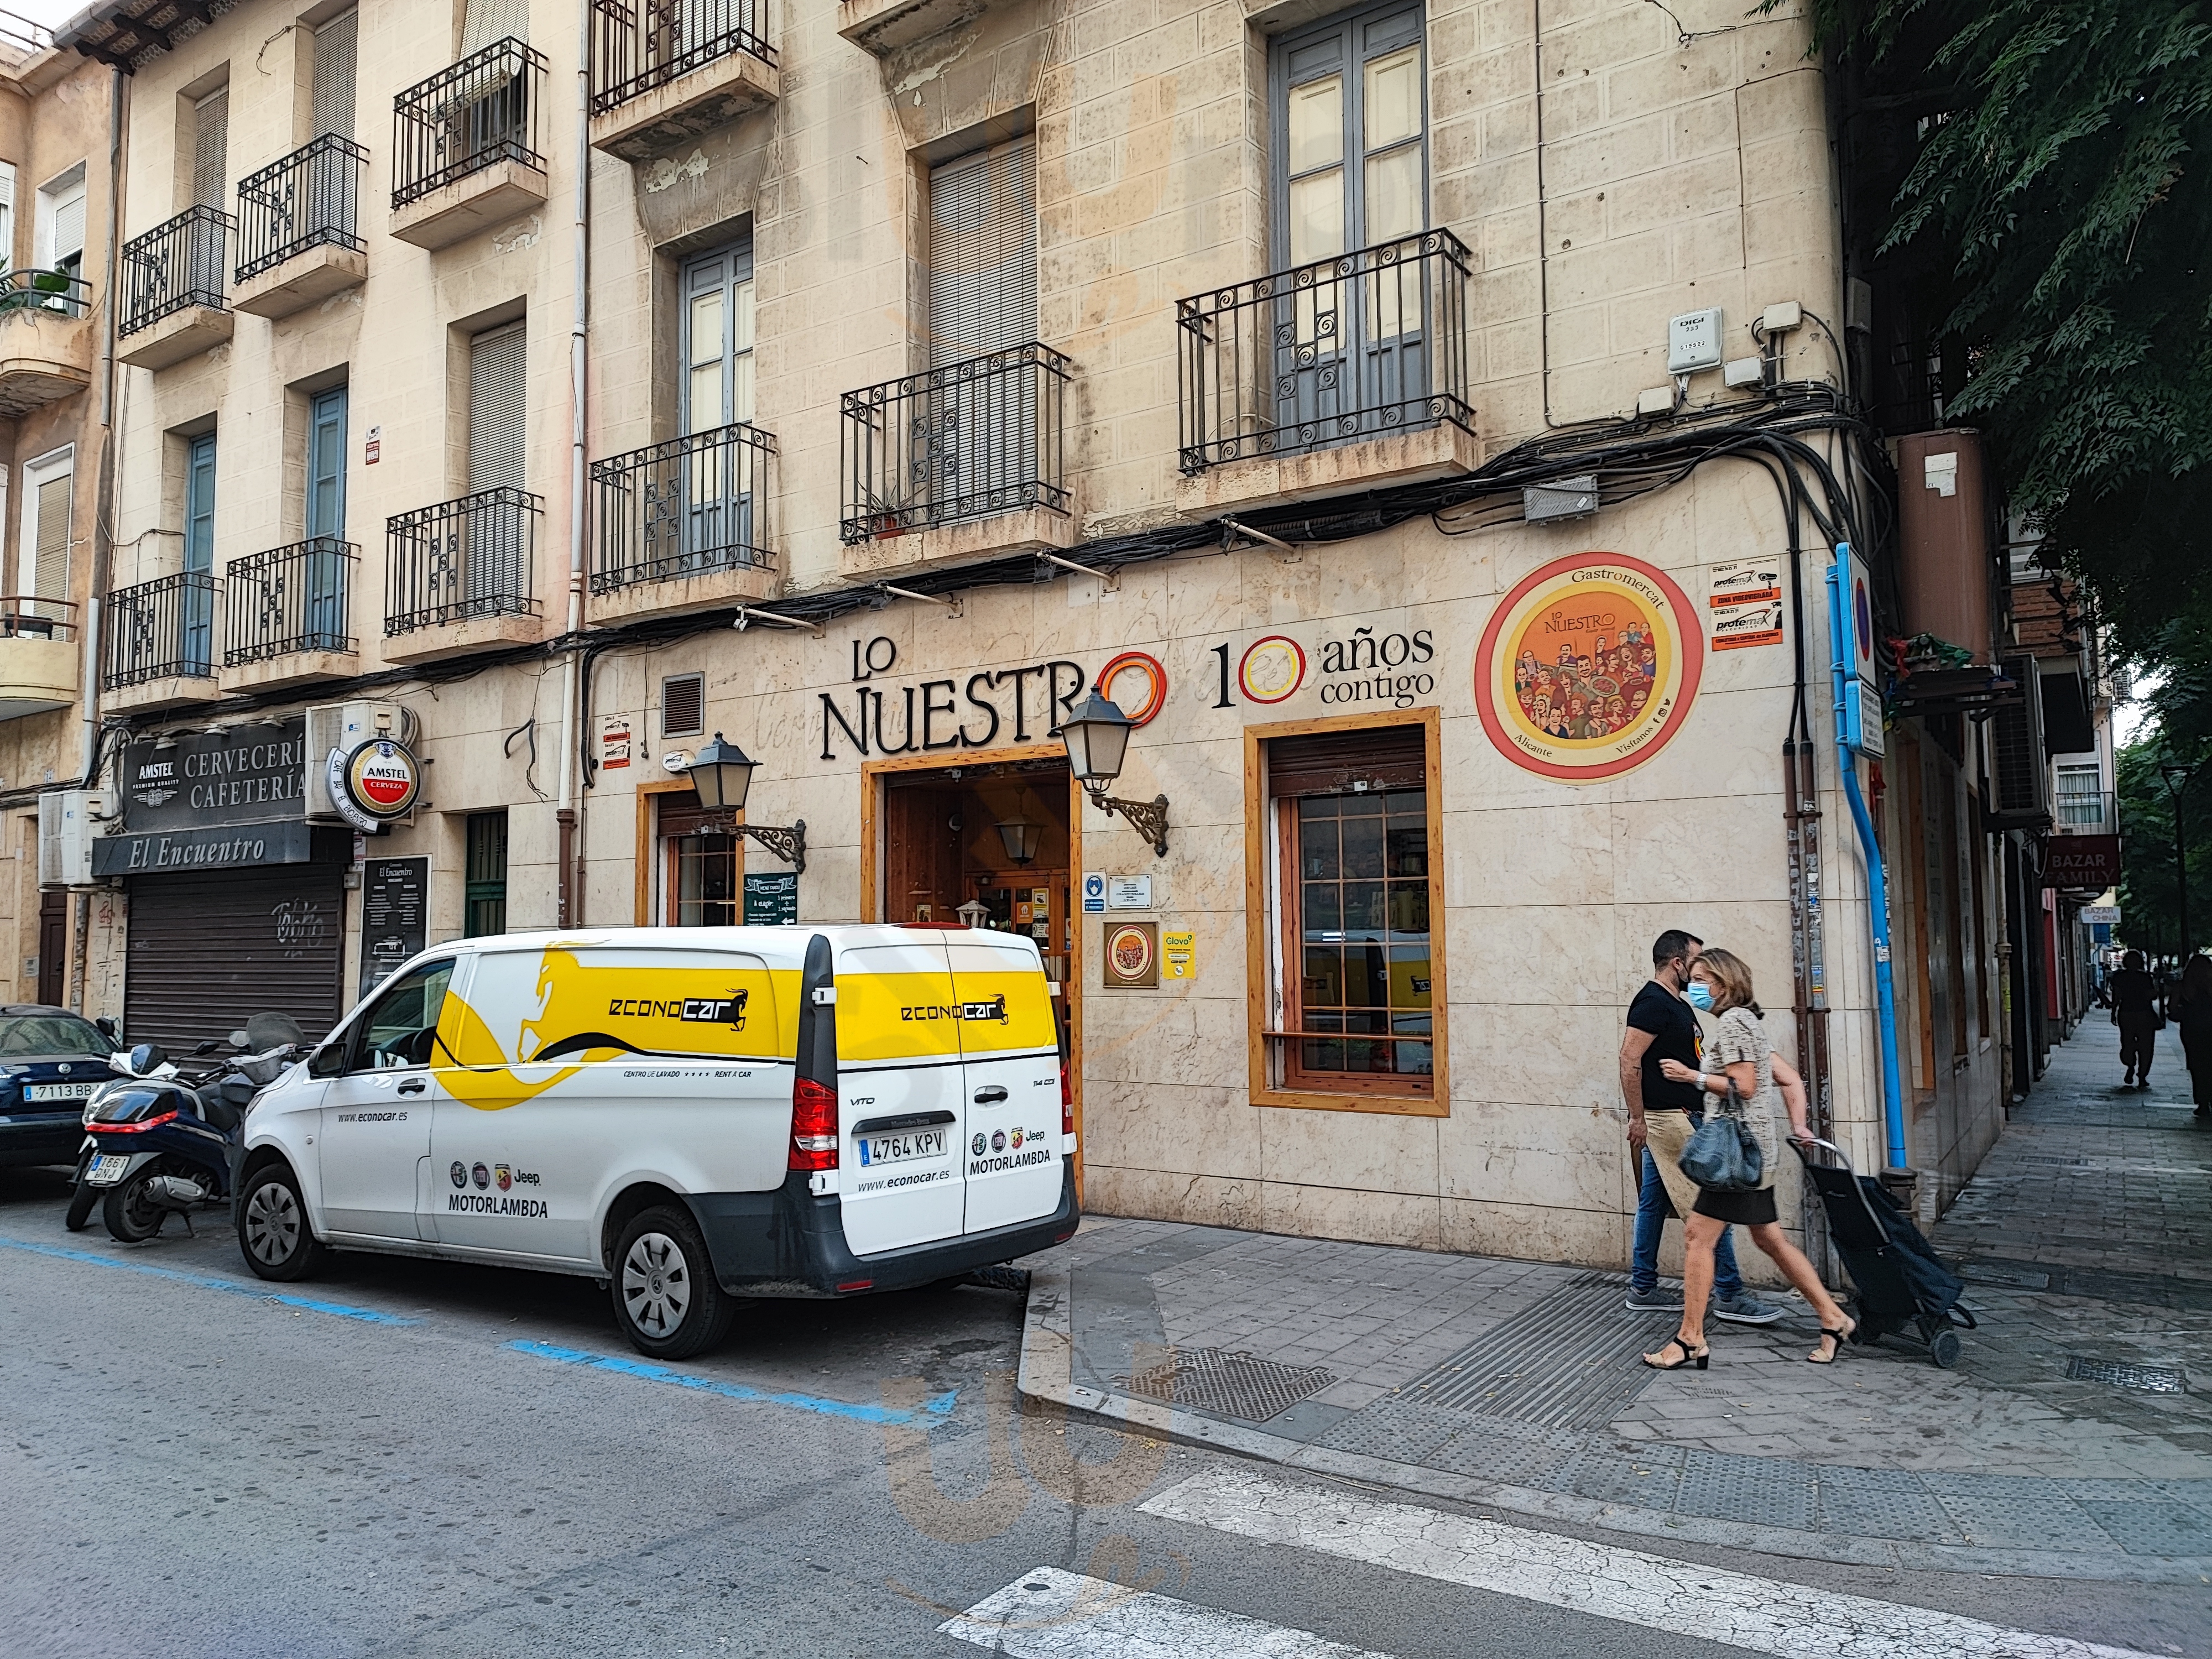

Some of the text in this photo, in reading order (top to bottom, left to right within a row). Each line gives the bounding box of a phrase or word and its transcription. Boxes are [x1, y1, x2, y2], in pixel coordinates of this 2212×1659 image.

[1680, 317, 1704, 327] DIGI
[1680, 341, 1705, 350] 015522
[1571, 568, 1665, 609] Gastromercat
[1545, 613, 1616, 634] NUESTRO
[1552, 612, 1562, 621] LO
[852, 636, 896, 681] LO
[1210, 625, 1435, 710] 10 años
[1320, 668, 1435, 708] contigo
[818, 651, 1168, 760] NUESTRO
[185, 732, 305, 778] CERVECERÍ
[1514, 733, 1553, 758] Alicante
[138, 761, 174, 780] AMSTEL
[367, 768, 407, 779] AMSTEL
[370, 781, 403, 790] CERVEZA
[128, 836, 264, 869] El Encuentro
[2052, 853, 2106, 868] BAZAR
[2045, 868, 2115, 884] FAMILY
[1166, 937, 1189, 945] Glovo
[608, 999, 731, 1020] econocar
[901, 1004, 997, 1021] econocar
[38, 1086, 72, 1098] 7113
[850, 1097, 875, 1106] VITO
[338, 1110, 408, 1123] www.econocar.es
[1026, 1130, 1045, 1142] Jeep
[873, 1135, 911, 1161] 4764
[915, 1132, 942, 1155] KPV
[969, 1149, 1051, 1176] MOTORLAMBDA
[514, 1169, 540, 1186] Jeep
[858, 1169, 950, 1192] www.econocar.es
[448, 1194, 549, 1219] MOTORLAMBDA
